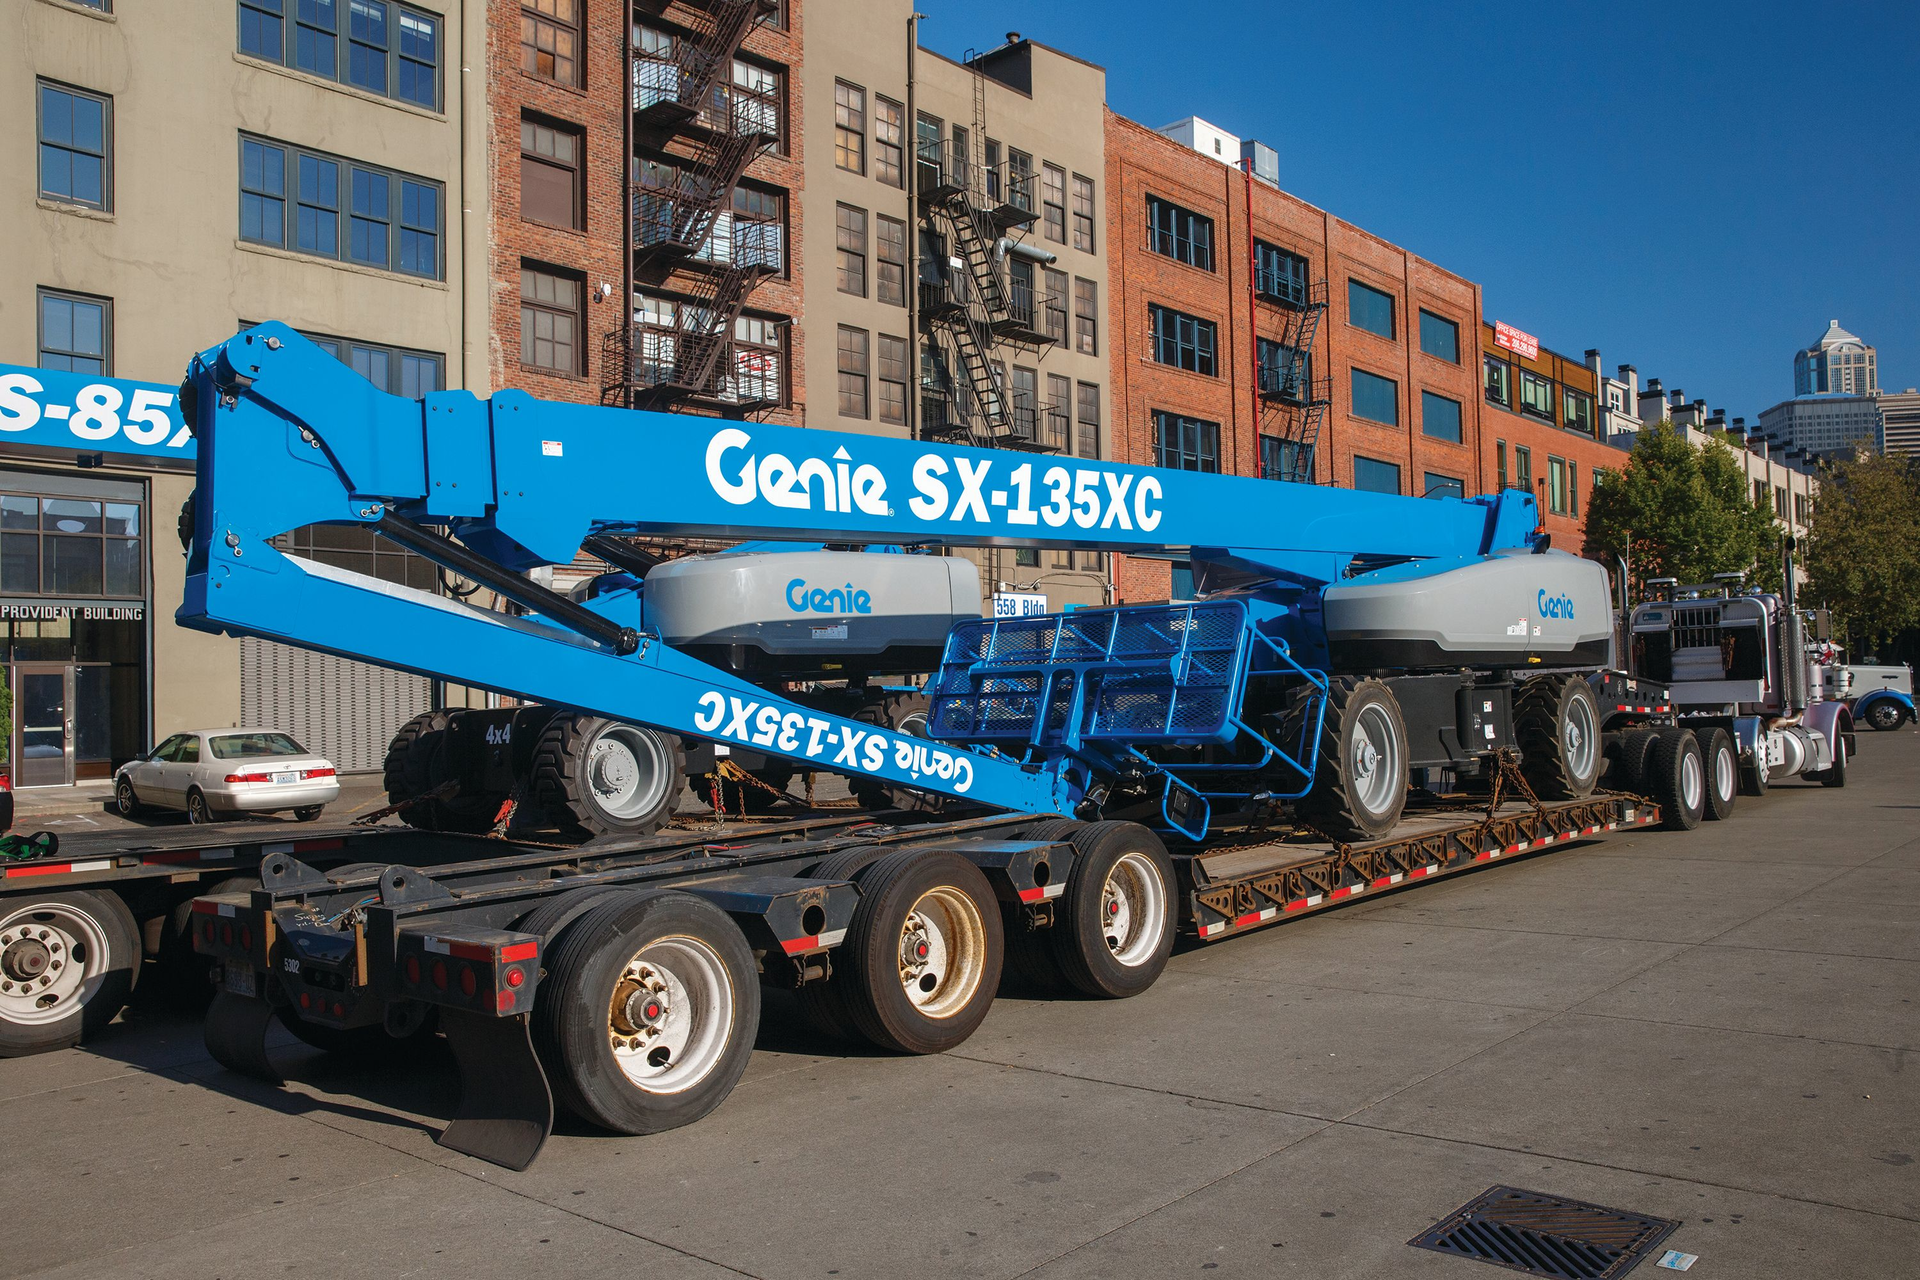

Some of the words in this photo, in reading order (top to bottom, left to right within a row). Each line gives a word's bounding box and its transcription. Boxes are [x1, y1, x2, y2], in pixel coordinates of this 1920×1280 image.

[0, 373, 197, 448] S-85
[705, 428, 889, 516] Genie
[908, 453, 1163, 532] SX-135XC
[785, 578, 872, 614] Genie
[997, 598, 1016, 616] 558
[1538, 588, 1574, 619] Genie
[1, 605, 78, 619] PROVIDENT
[84, 607, 143, 620] BUILDING
[485, 723, 511, 745] 4x4
[694, 691, 888, 772] SX-135XC
[894, 740, 973, 793] Genie
[284, 957, 300, 974] 5302
